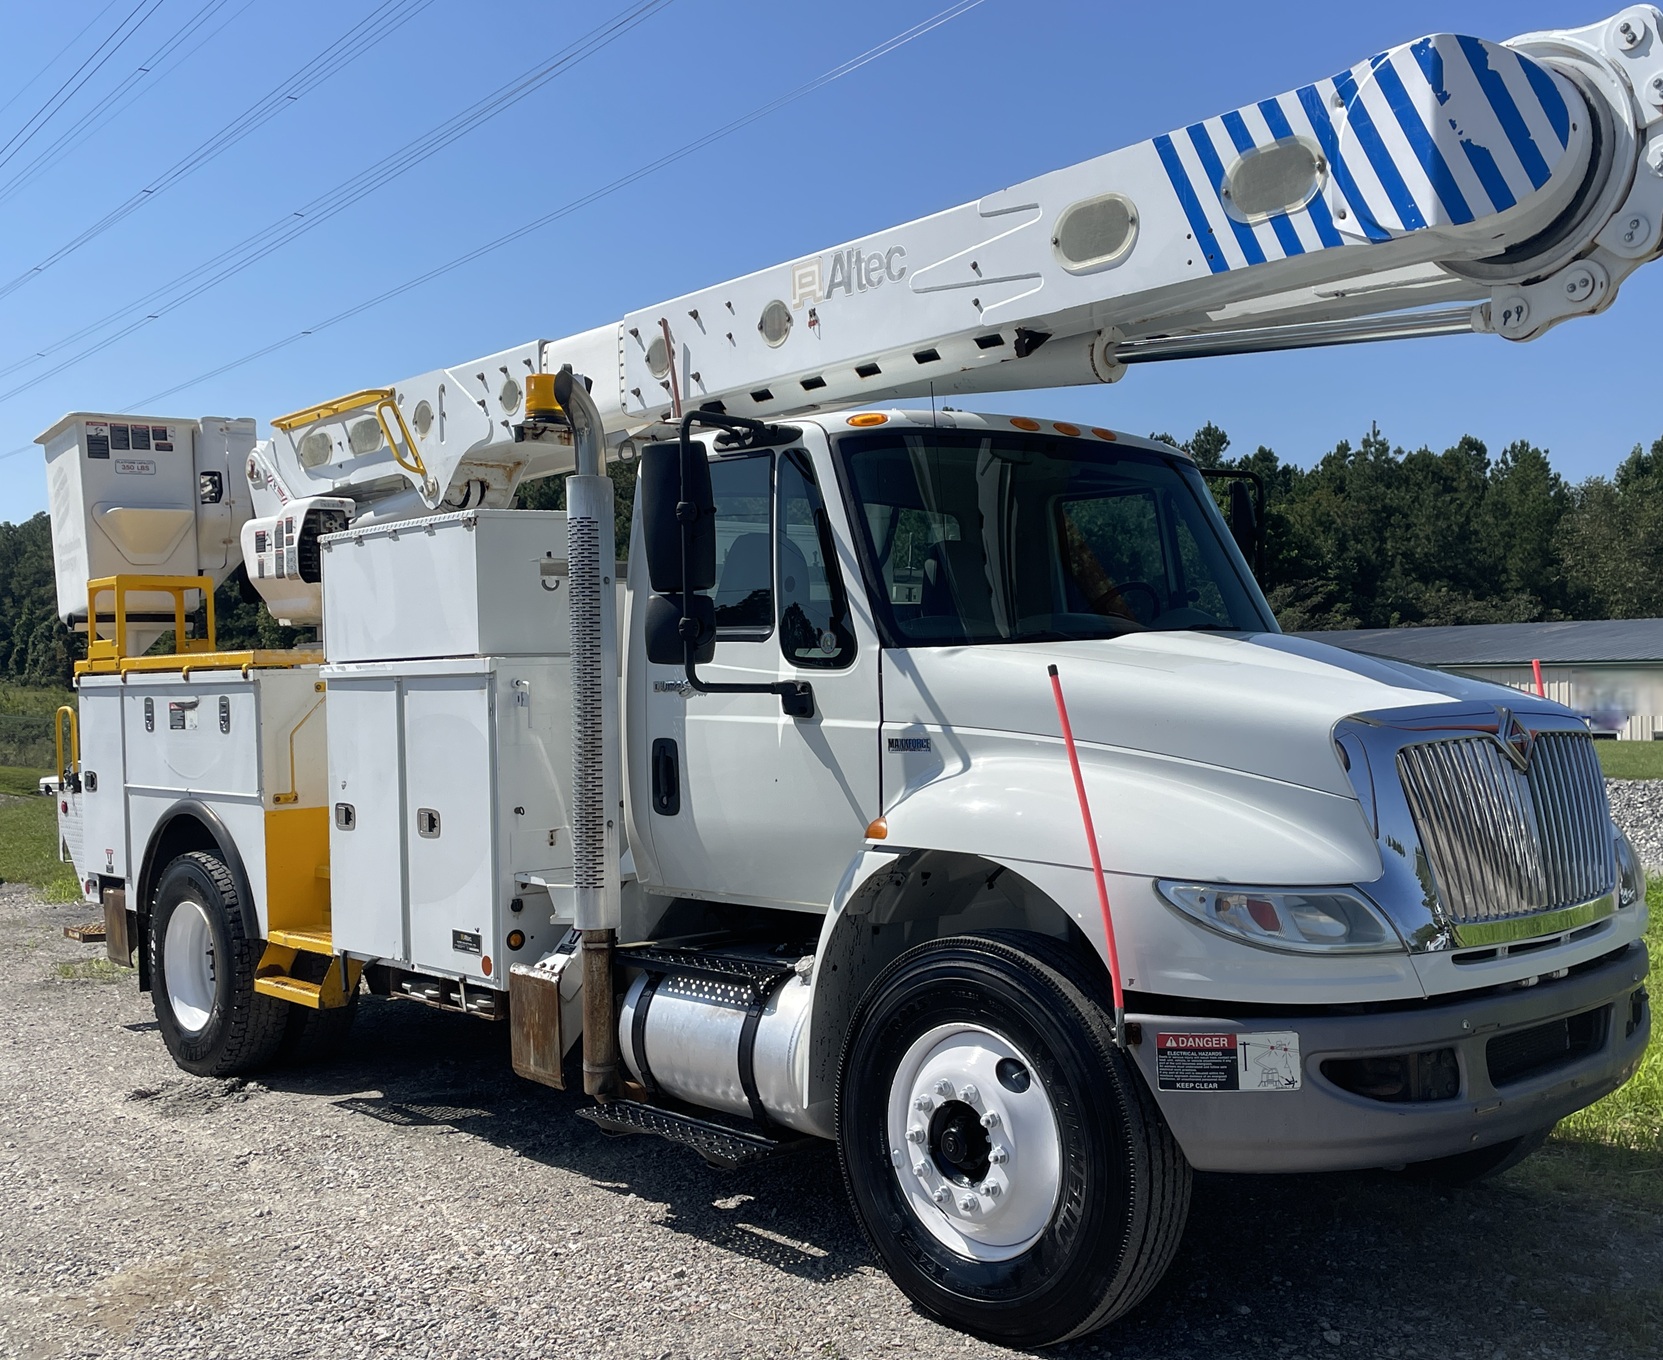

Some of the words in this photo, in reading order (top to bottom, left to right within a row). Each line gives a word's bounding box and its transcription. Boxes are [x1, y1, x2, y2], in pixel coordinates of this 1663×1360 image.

[825, 245, 907, 300] Altec
[1178, 1037, 1228, 1047] DANGER
[1053, 1084, 1087, 1255] MIHELIN
